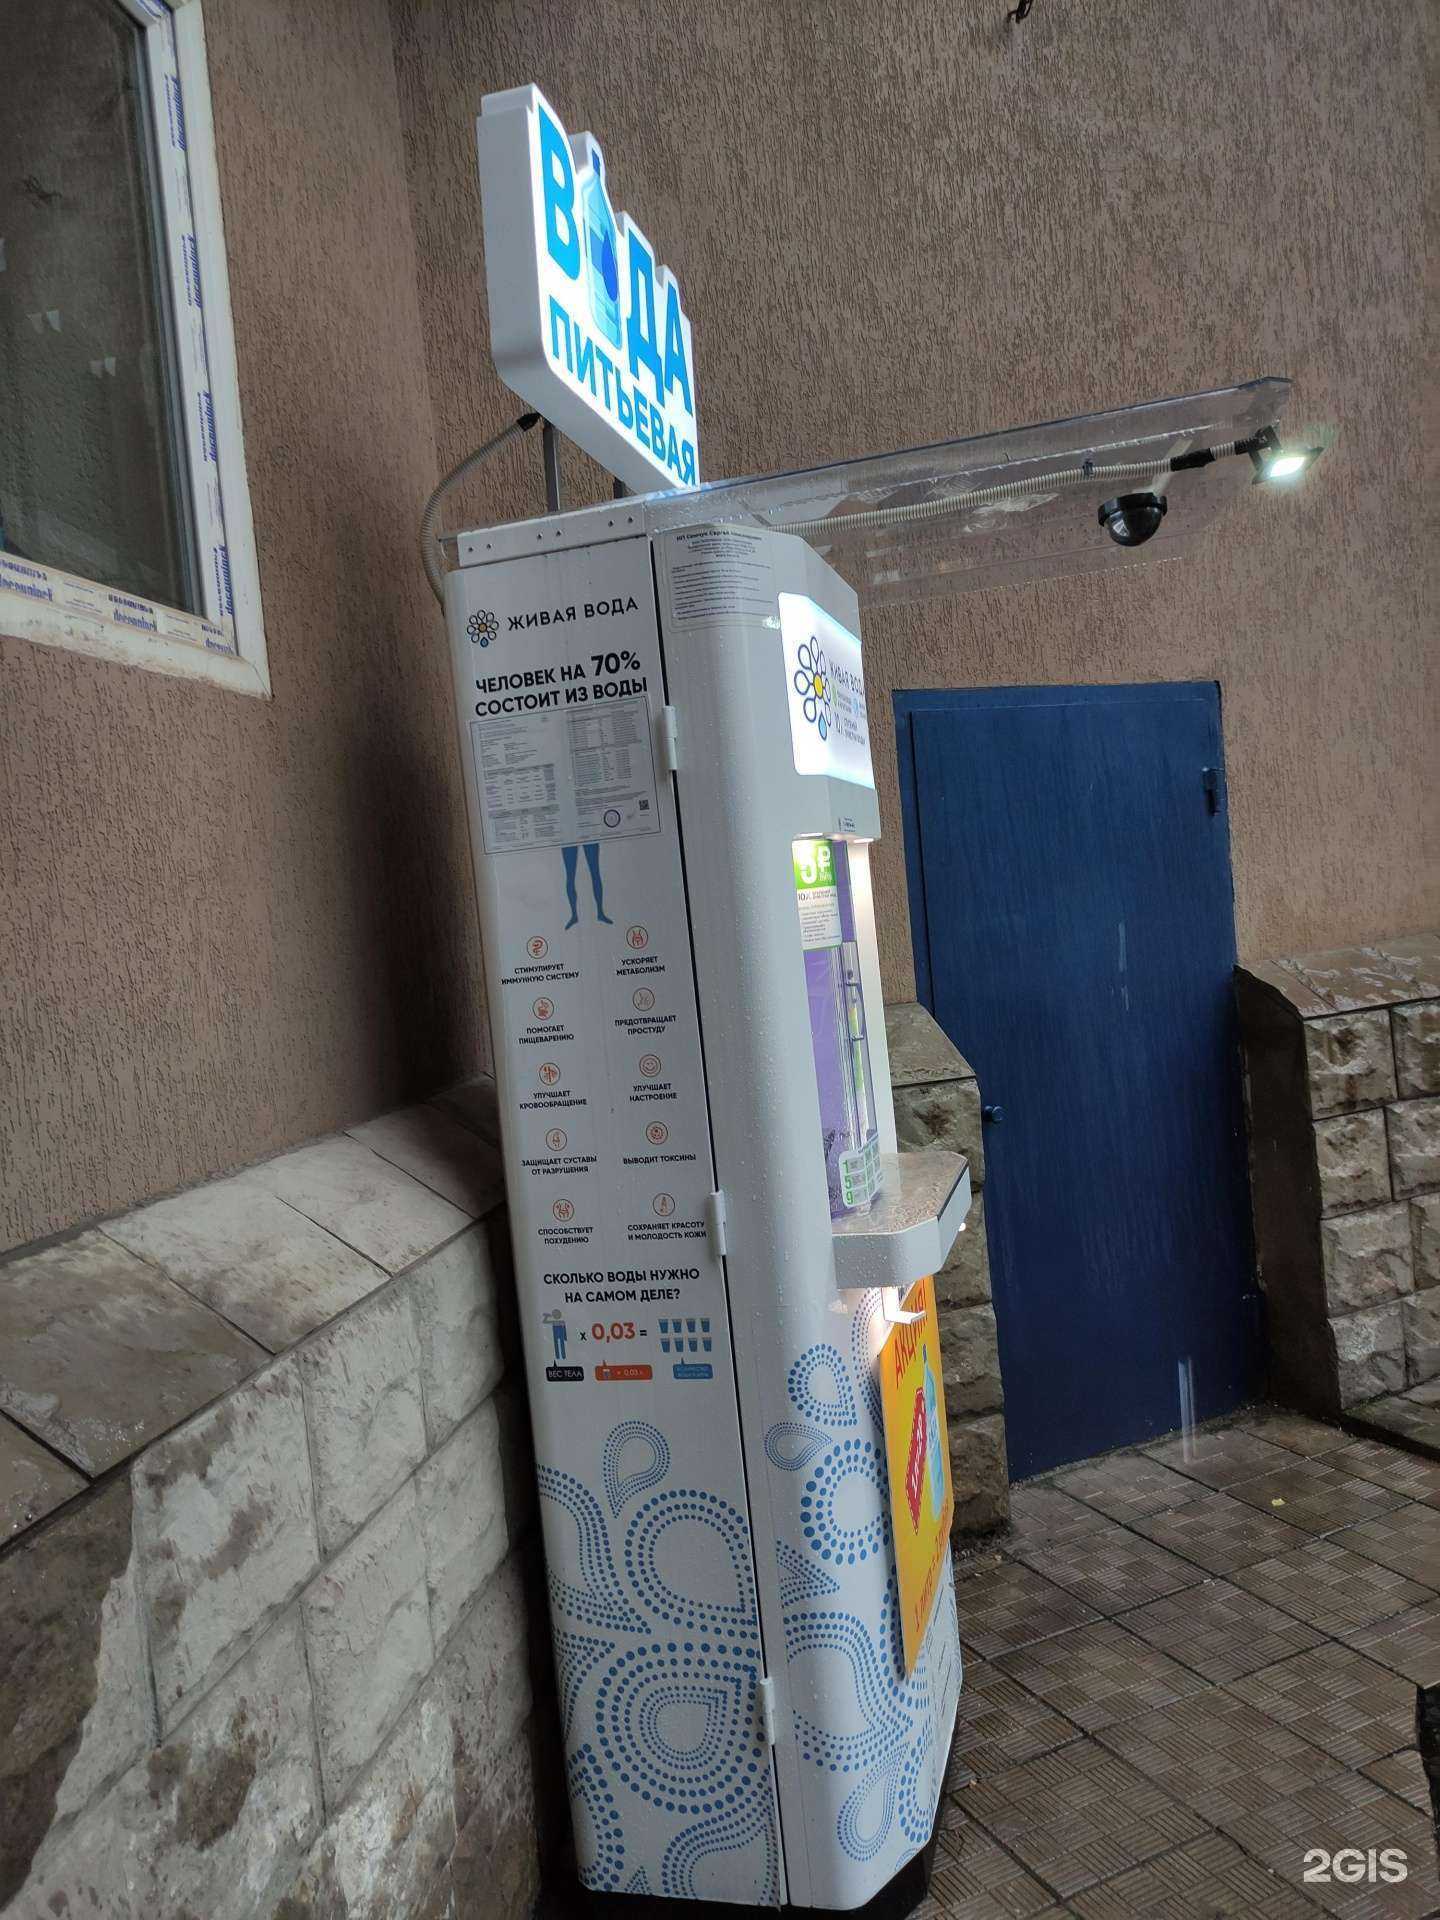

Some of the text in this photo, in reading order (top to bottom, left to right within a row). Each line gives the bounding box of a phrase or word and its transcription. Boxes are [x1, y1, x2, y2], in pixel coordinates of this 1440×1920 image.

[549, 293, 696, 487] ПИТЬЕВАЯ
[507, 596, 639, 631] ЖИВАЯ ВОДА
[475, 650, 641, 693] ЧЕЛОВЕК НА 70%
[475, 677, 648, 717] СОСТОИТ ИЗ ВОДЫ
[620, 955, 659, 966] УСКОРЯЕТ
[514, 963, 565, 974] СТИМУЛИРУЕТ
[616, 965, 666, 976] МЕТАБОЛИЗМ
[501, 971, 580, 985] ИММУННУЮ СИСТЕМУ
[614, 1015, 677, 1027] ПРЕДОТВРАЩАЕТ
[526, 1024, 565, 1034] ПОМОГАЕТ
[627, 1026, 666, 1036] ПРОСТУДУ
[518, 1034, 575, 1045] ПИЩЕВАРЕНИЮ
[632, 1083, 672, 1093] УЛУЧШАЕТ
[533, 1090, 571, 1099] УЛУЧШАЕТ
[629, 1092, 678, 1102] НАСТРОЕНИЕ
[519, 1098, 588, 1110] КРОВООБРАЩЕНИЕ
[521, 1155, 597, 1167] ЗАЩИЩАЕТ СУСТАВЫ
[623, 1153, 696, 1166] ВЫВОДИТ ТОКСИНЫ
[531, 1165, 589, 1175] ОТ РАЗРУШЕНИЯ
[538, 1226, 594, 1236] СПОСОБСТВУЕТ
[627, 1221, 705, 1231] СОХРАНЯЕТ КРАСОТУ
[544, 1236, 589, 1245] ПОХУДЕНИЮ
[634, 1232, 683, 1241] МОЛОДОСТЬ
[684, 1230, 707, 1239] КОЖИ
[543, 1268, 700, 1285] СКОЛЬКО ВОДЫ НУЖНО
[565, 1288, 681, 1303] НА САМОМ ДЕЛЕ?
[591, 1322, 636, 1343] 0,03
